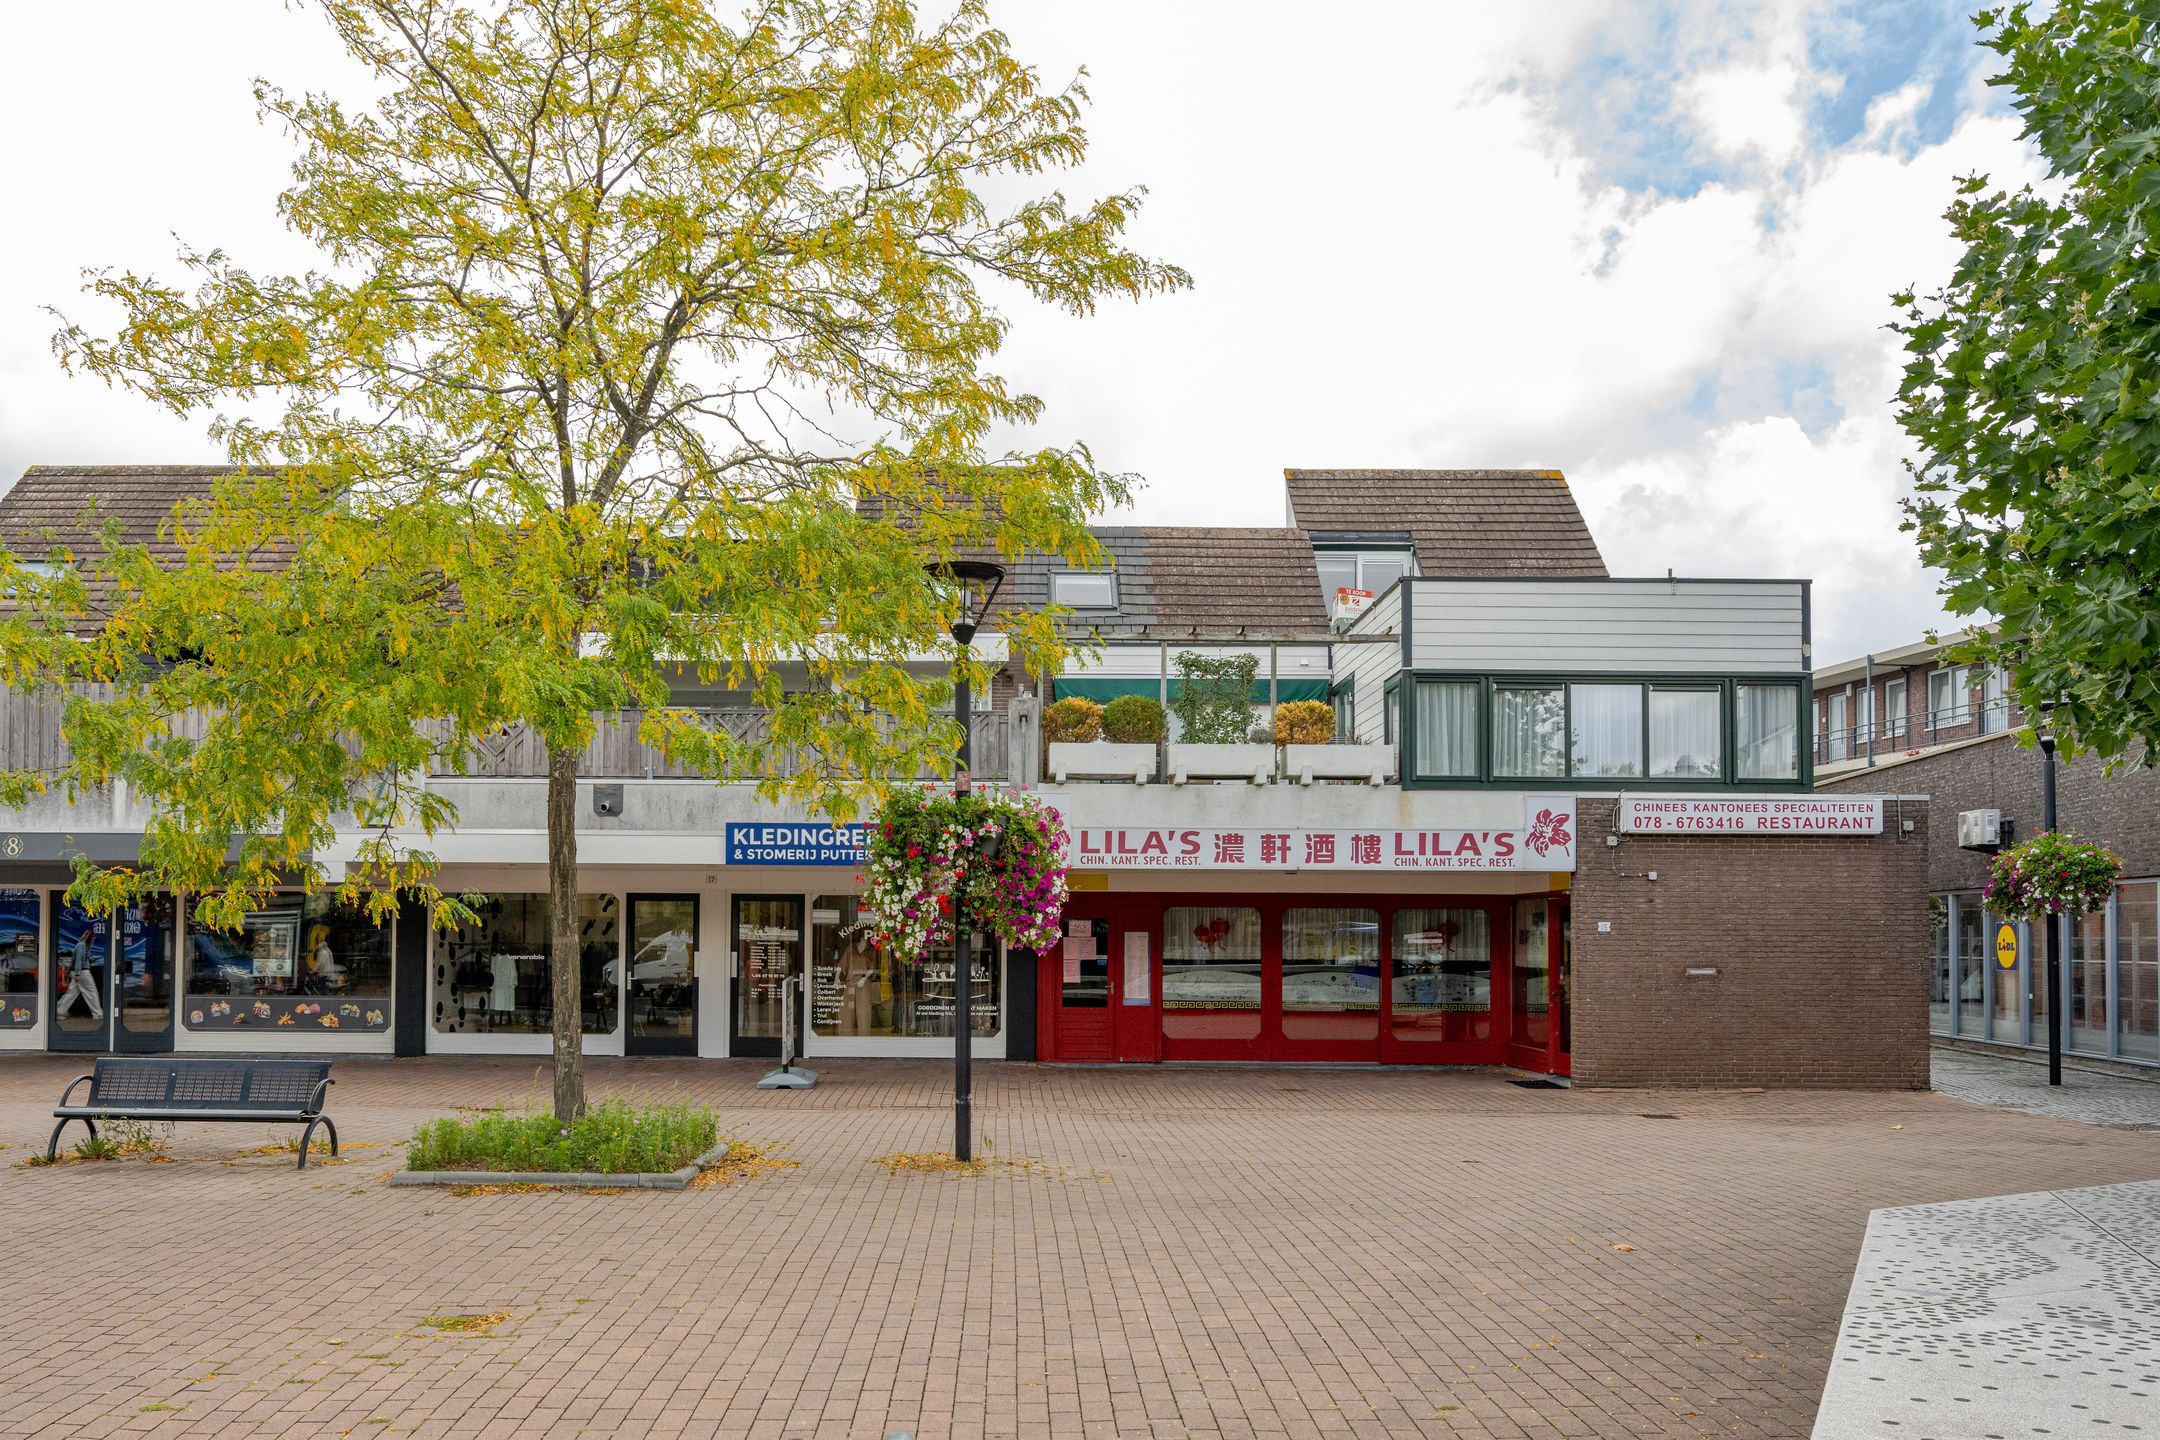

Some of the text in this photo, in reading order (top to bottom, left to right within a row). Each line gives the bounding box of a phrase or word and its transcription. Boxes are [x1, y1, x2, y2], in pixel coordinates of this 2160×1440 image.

[1634, 803, 1874, 813] CHINEES KANTONEES SPECIALITEITEN
[1634, 817, 1662, 829] 078
[1676, 817, 1744, 829] 6763416
[1757, 817, 1874, 829] RESTAURANT
[7, 838, 19, 856] 8
[1081, 831, 1201, 855] LILA'S
[1214, 833, 1382, 864] 濃軒酒樓
[1395, 832, 1515, 856] LILA'S
[733, 849, 743, 860] &
[747, 849, 817, 860] STOMERIJ
[1080, 855, 1201, 866] CHIN. KANT. SPEC. REST.
[1394, 858, 1516, 867] CHIN. KANT. SPEC. REST.
